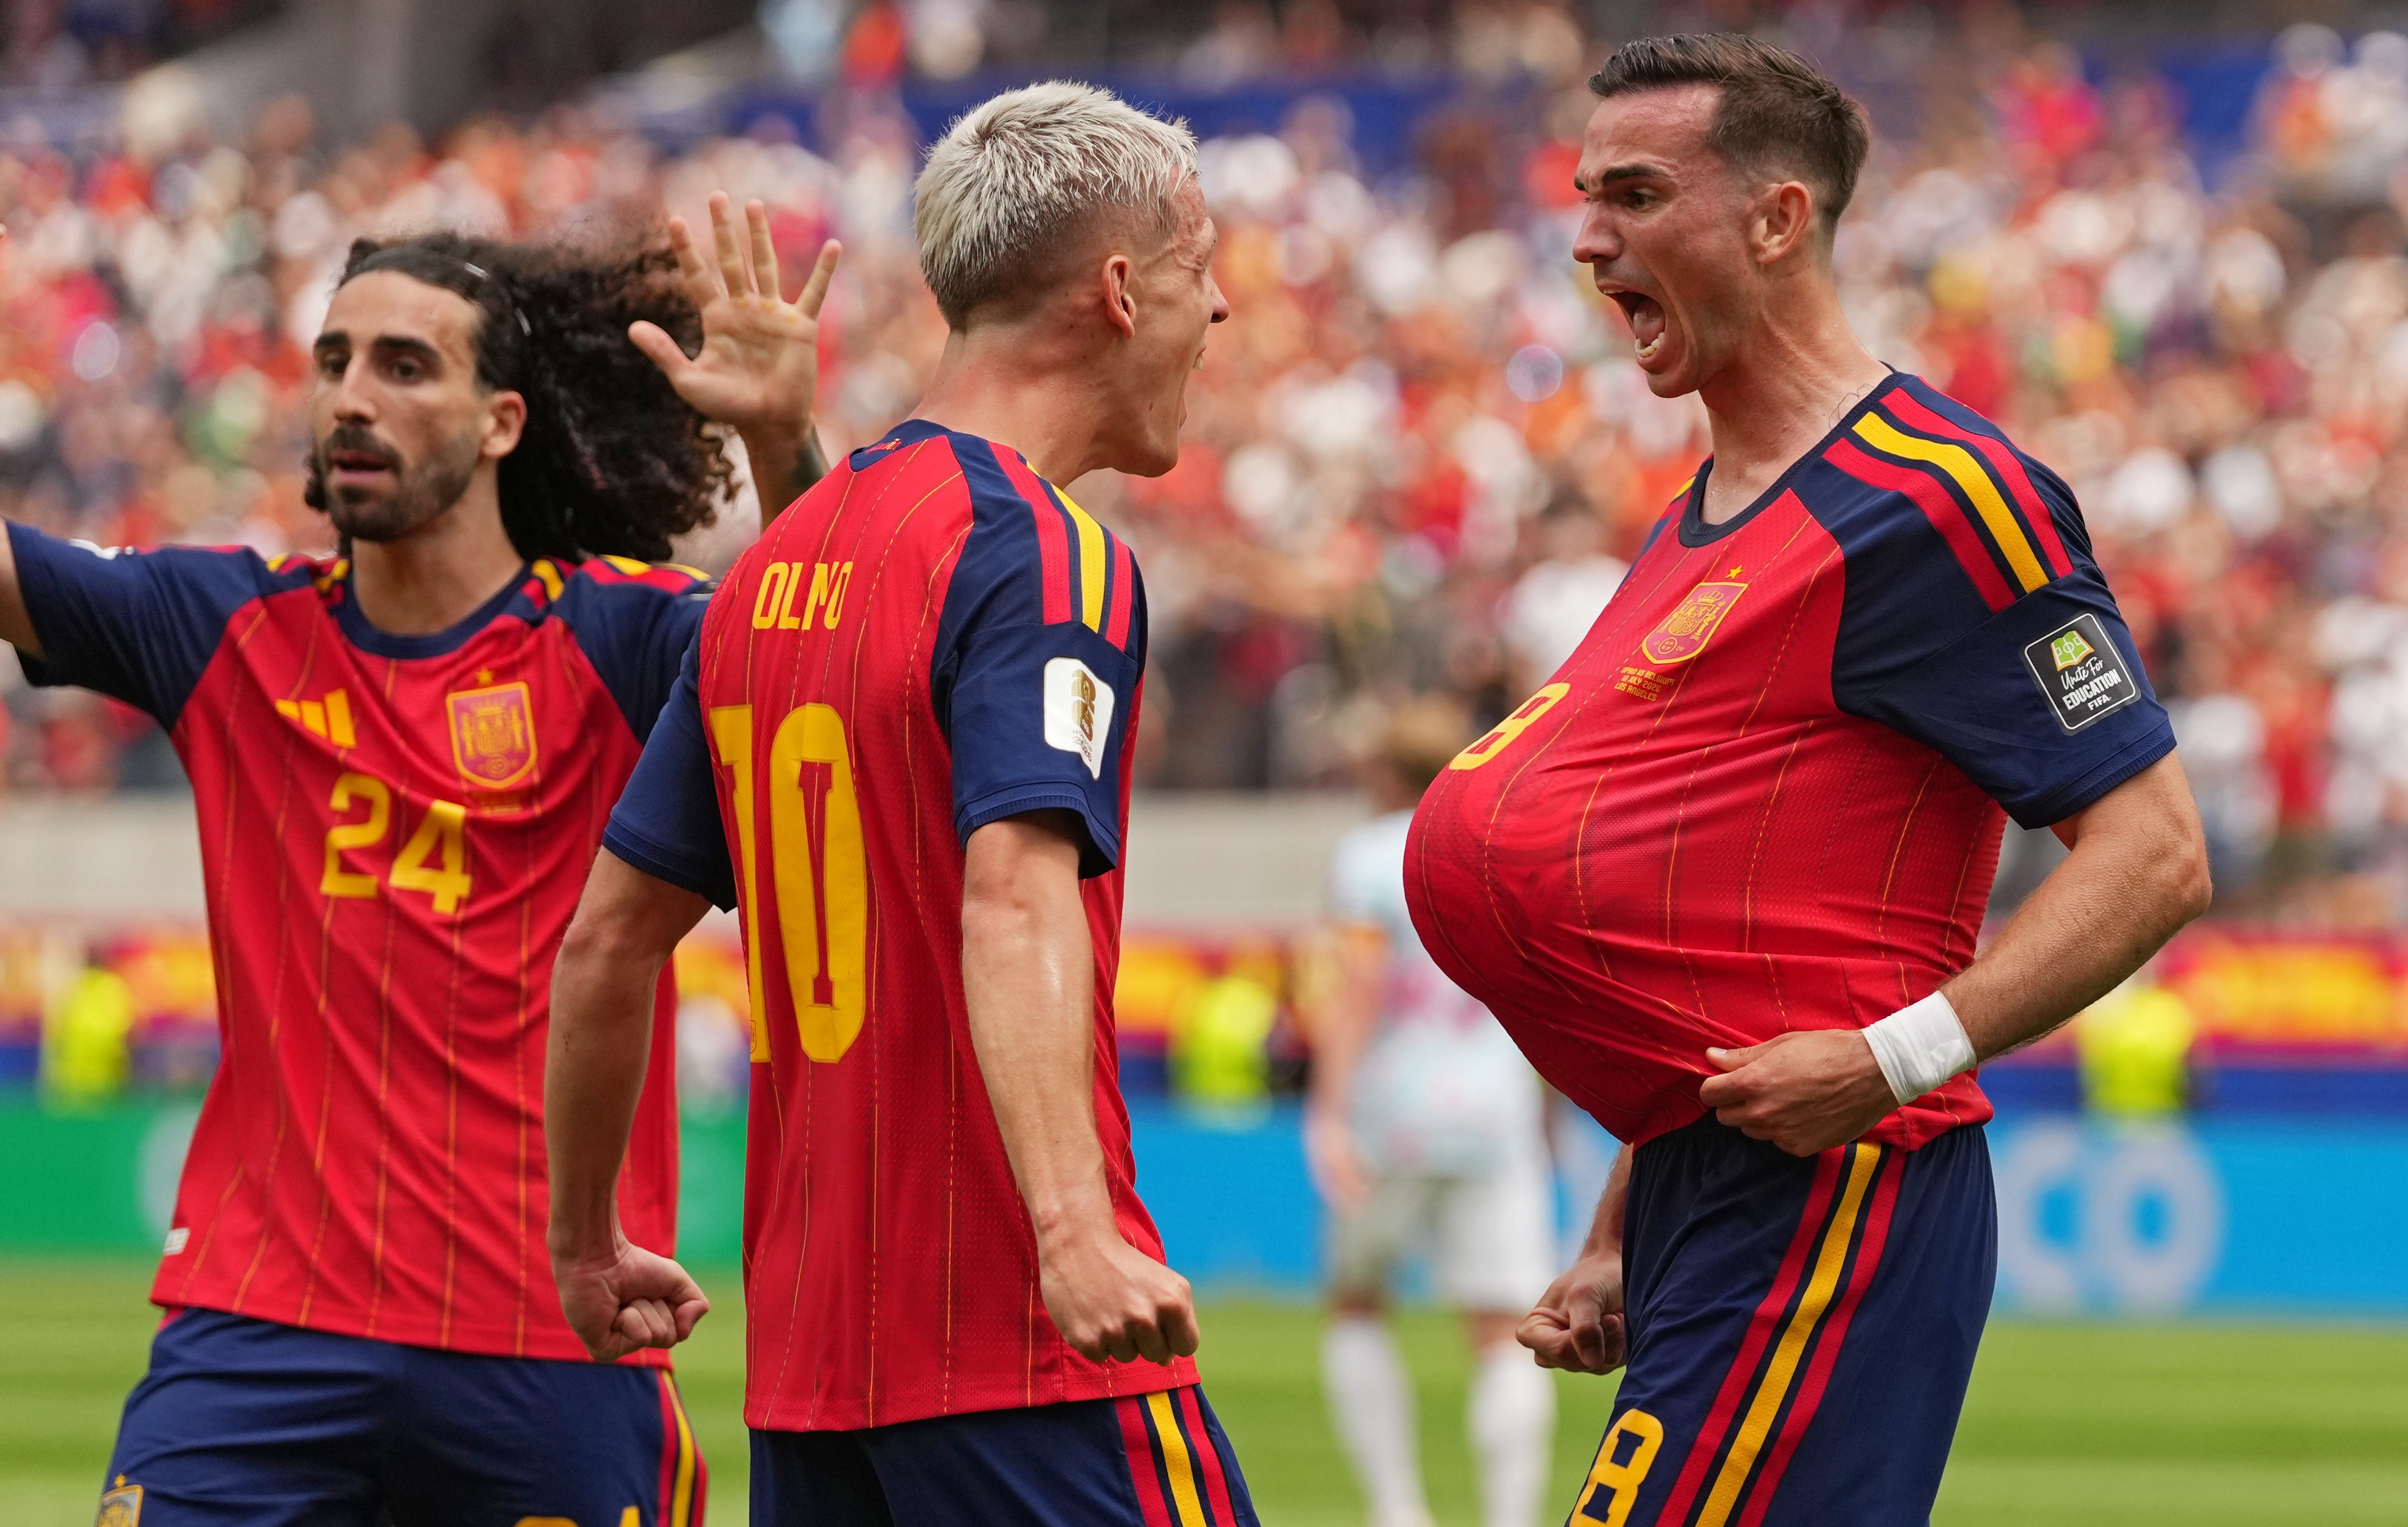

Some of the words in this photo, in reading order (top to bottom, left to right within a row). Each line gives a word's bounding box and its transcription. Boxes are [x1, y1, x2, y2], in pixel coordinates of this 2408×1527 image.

[1614, 682, 1627, 691] LOS
[1627, 685, 1658, 702] ANGELES
[1621, 667, 1638, 675] SPAIN
[1644, 671, 1674, 686] BELGIUM
[1627, 676, 1642, 685] JULY
[1642, 680, 1661, 692] 2026
[2061, 666, 2089, 690] Unite
[2086, 656, 2103, 676] For
[2062, 668, 2121, 710] EDUCATION
[2087, 694, 2111, 711] FIFA
[1449, 682, 1571, 771] 8
[319, 771, 473, 915] 24
[709, 703, 866, 1063] 10
[1569, 1408, 1664, 1527] 8
